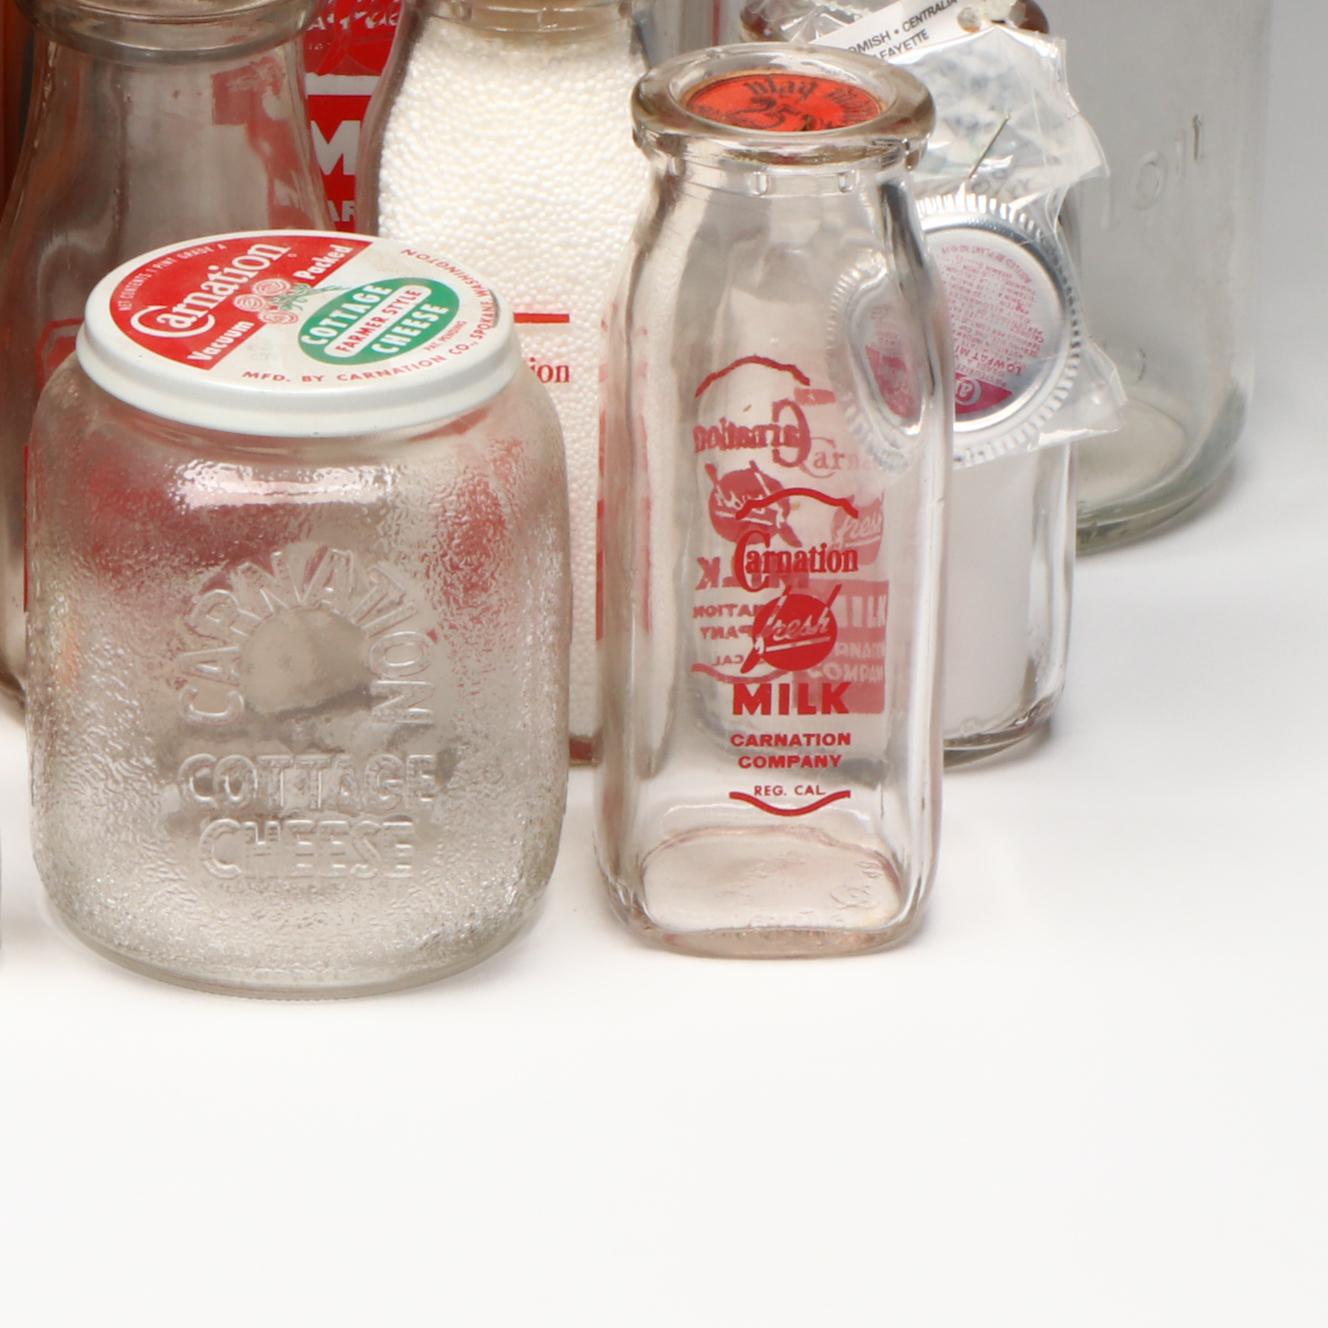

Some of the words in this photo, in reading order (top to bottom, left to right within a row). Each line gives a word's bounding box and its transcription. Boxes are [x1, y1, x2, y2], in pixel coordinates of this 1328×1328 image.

[293, 244, 354, 281] Packed
[400, 248, 490, 298] WASHINGTON
[130, 243, 292, 338] Carnation
[300, 284, 394, 346] COTTAGE
[334, 315, 385, 353] FARMER
[382, 288, 423, 317] STYLE
[371, 303, 450, 354] CHEESE
[469, 299, 498, 341] SPOKANE
[187, 320, 255, 362] Vacuum
[242, 370, 292, 383] MFD.
[301, 375, 326, 383] BY
[336, 354, 447, 383] CARNATION
[972, 352, 1023, 377] LOWFAT
[735, 530, 860, 592] Carnation
[176, 545, 436, 726] CARNATION
[754, 594, 831, 653] fresh
[732, 681, 852, 716] MILK
[730, 732, 851, 747] CARNATION
[177, 752, 439, 811] COTTAGE
[738, 754, 842, 769] COMPANY
[754, 785, 787, 796] REG.
[198, 816, 416, 880] CHEESE
